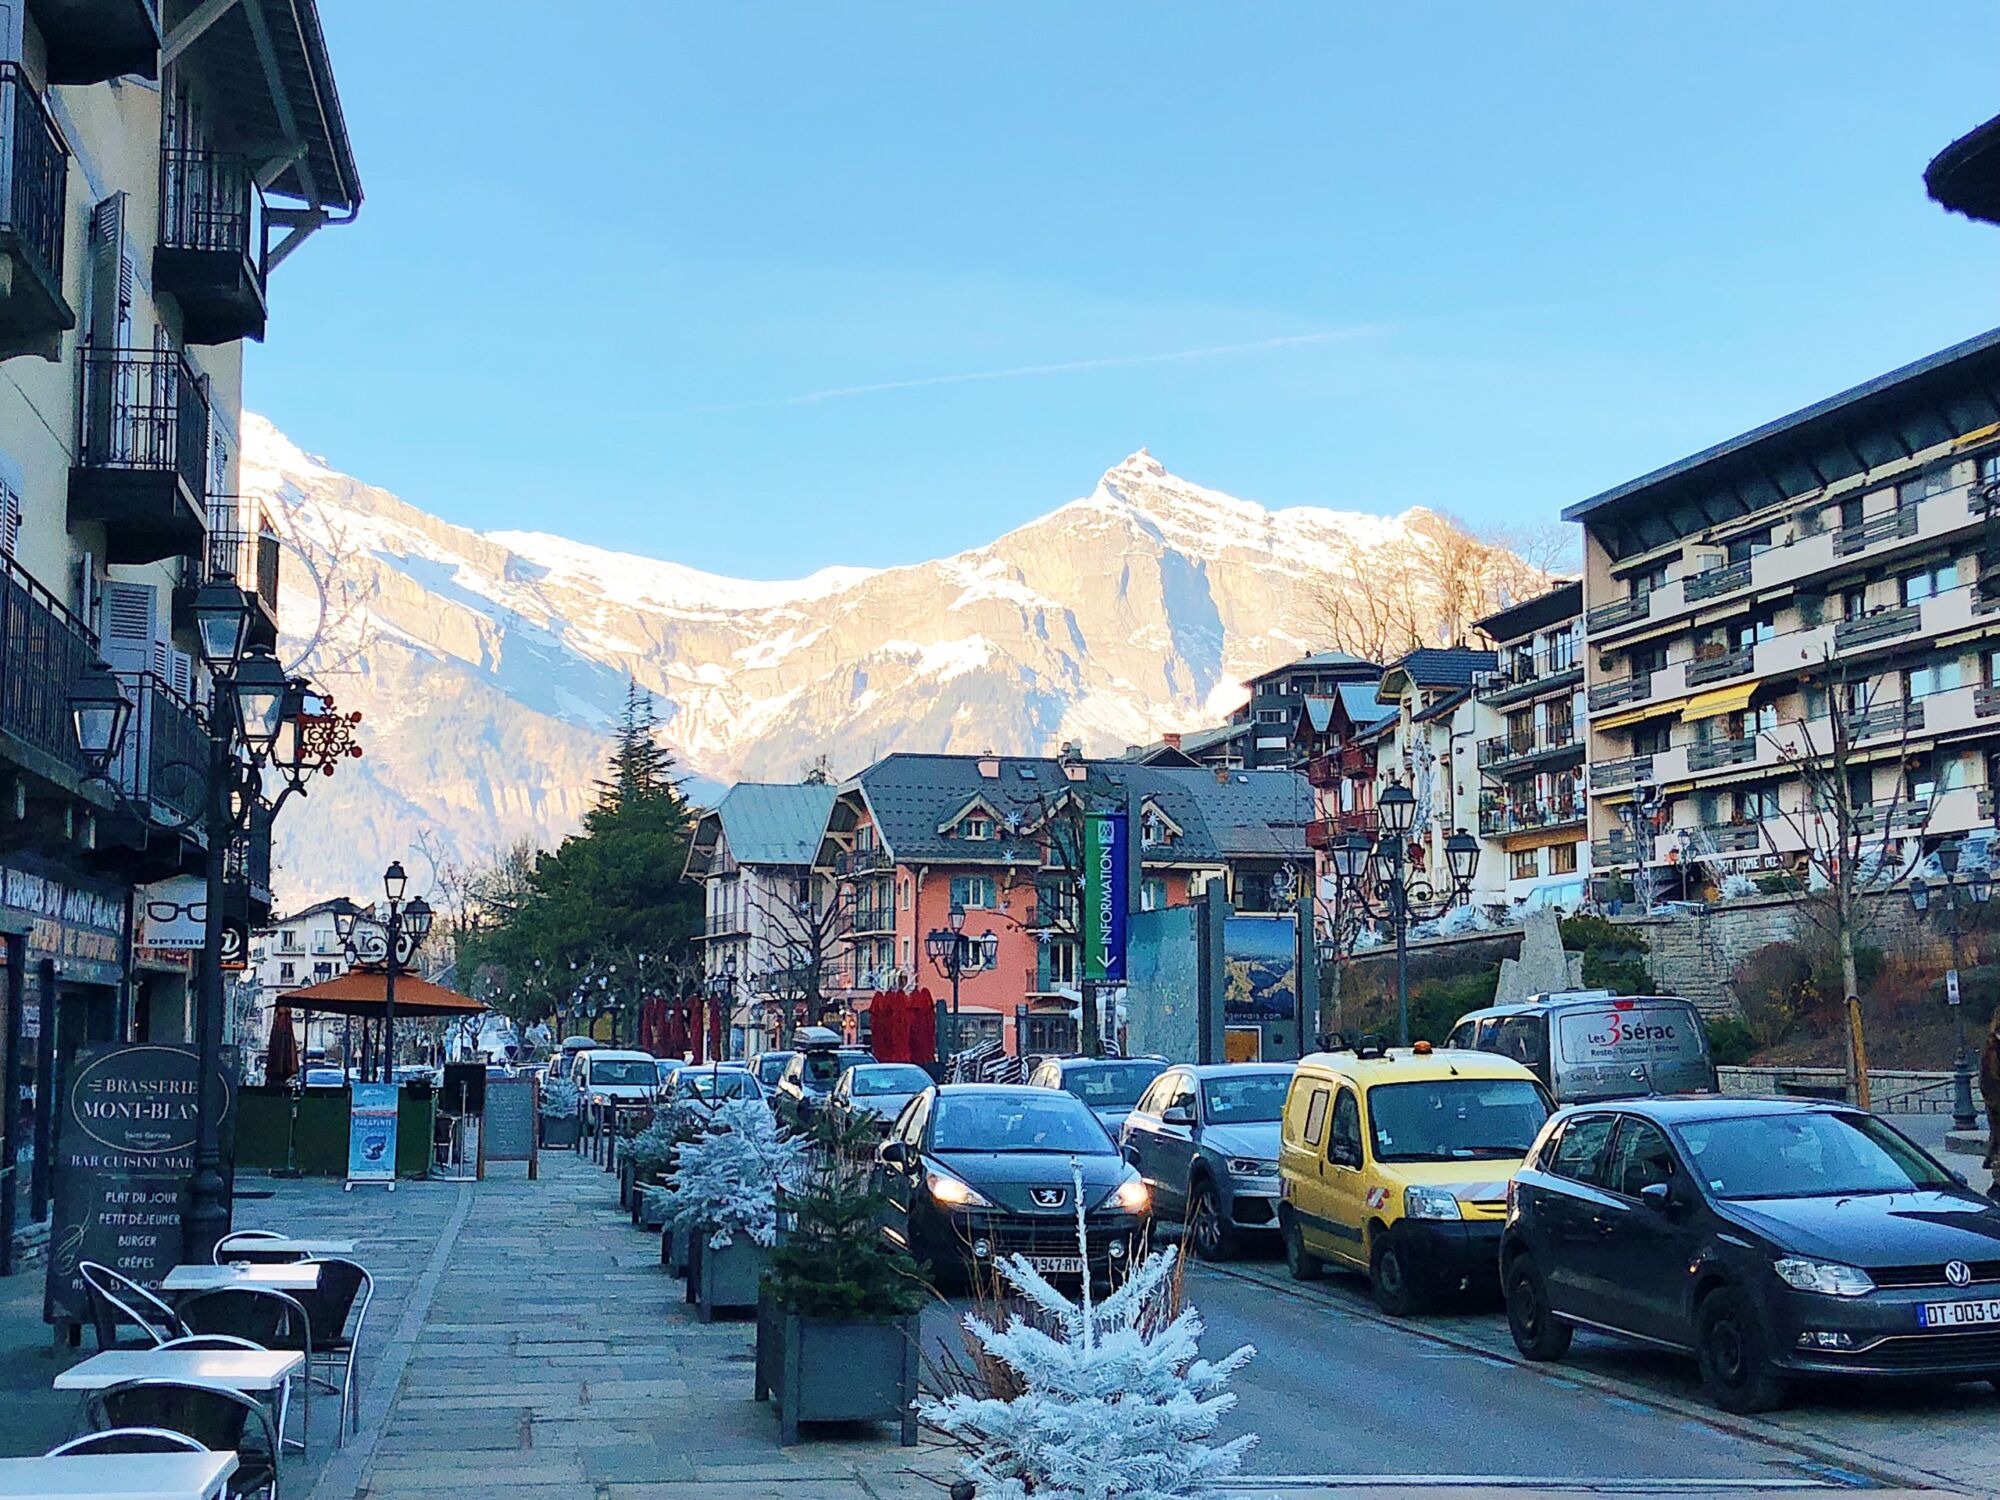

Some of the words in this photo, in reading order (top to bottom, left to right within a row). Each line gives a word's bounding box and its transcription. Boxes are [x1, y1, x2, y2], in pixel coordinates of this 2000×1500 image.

[1100, 846, 1112, 945] INFORMATION
[148, 938, 205, 946] OPTIQU
[1588, 1033, 1606, 1044] Les
[1600, 1013, 1621, 1047] 3
[1621, 1022, 1676, 1041] Sérac
[105, 1078, 199, 1095] BRASSERIE
[83, 1101, 199, 1120] MONT-BLAN
[71, 1154, 99, 1167] BAR
[103, 1155, 157, 1169] CUISINE
[105, 1191, 131, 1203] PLAT
[132, 1192, 146, 1203] DU
[148, 1192, 178, 1204] JOUR
[99, 1212, 127, 1225] PETIT
[118, 1235, 157, 1248] BURGER
[1926, 1301, 2000, 1325] DT-003-C
